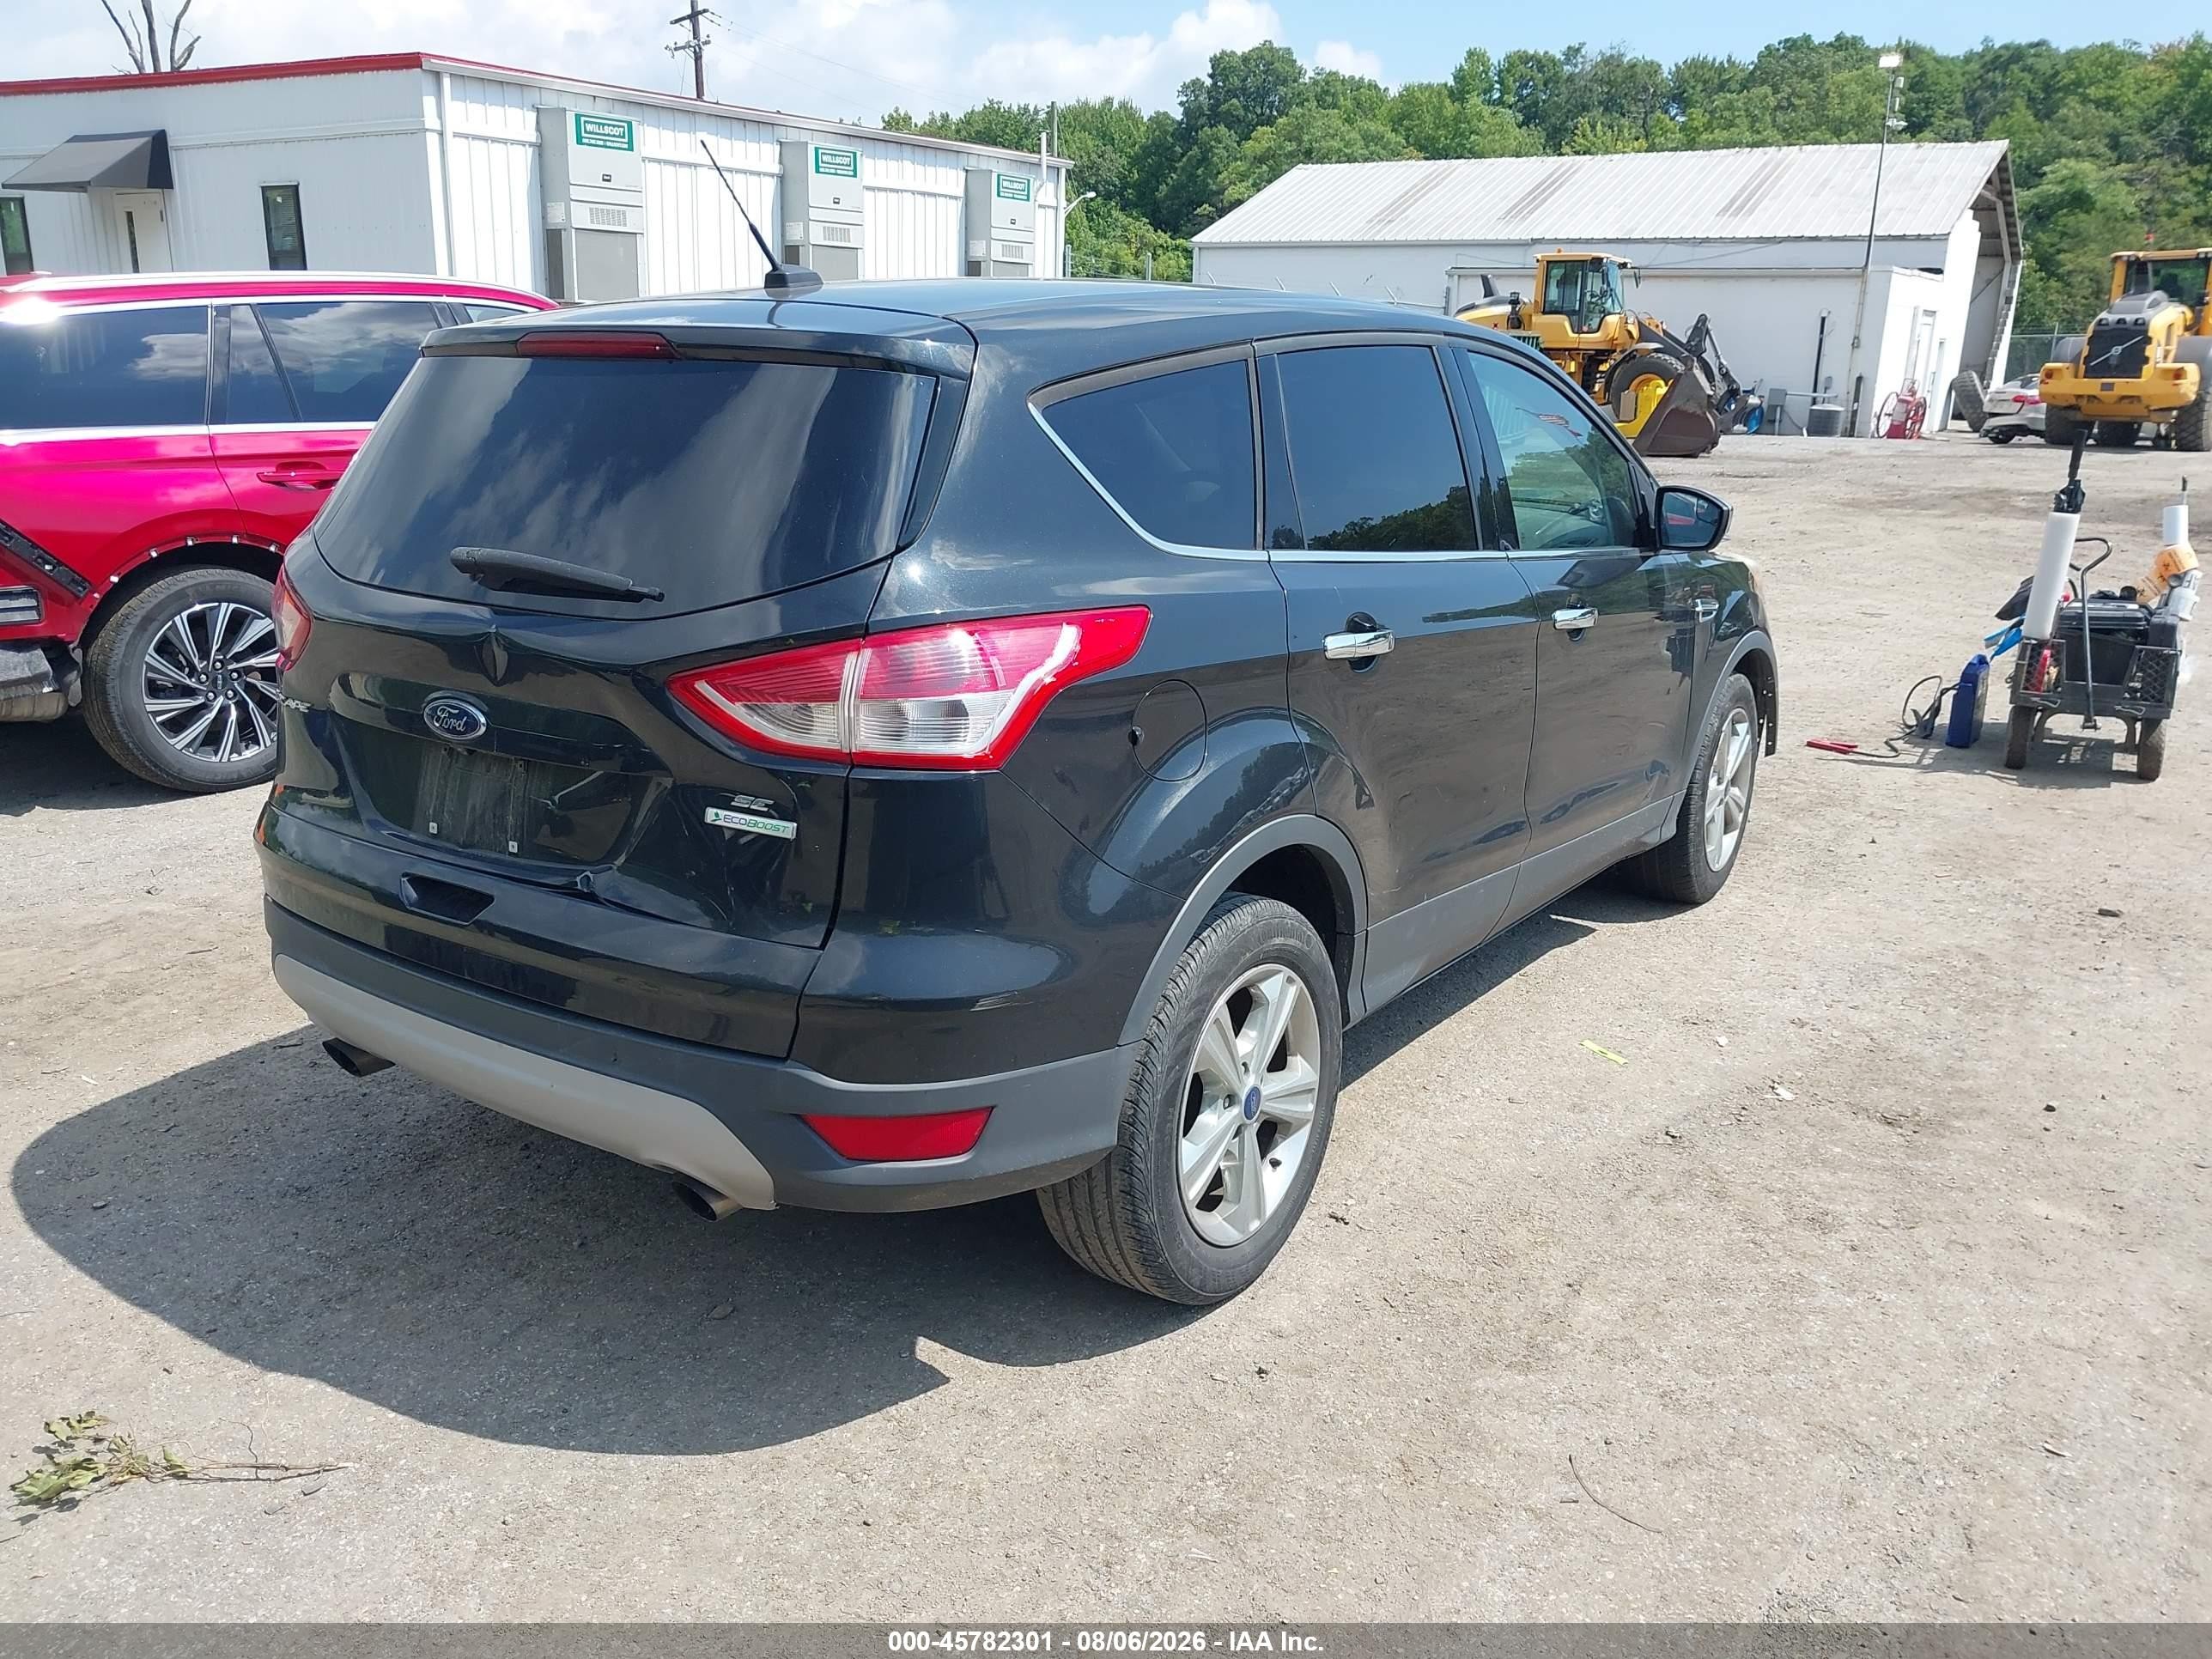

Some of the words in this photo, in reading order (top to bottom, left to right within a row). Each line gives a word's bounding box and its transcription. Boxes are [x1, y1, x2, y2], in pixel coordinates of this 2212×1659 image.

[585, 123, 624, 137] WILLSCOT
[822, 155, 851, 166] WILLSCOT
[433, 706, 468, 732] Ford
[730, 794, 775, 811] SE
[723, 814, 790, 833] ECOBOOST
